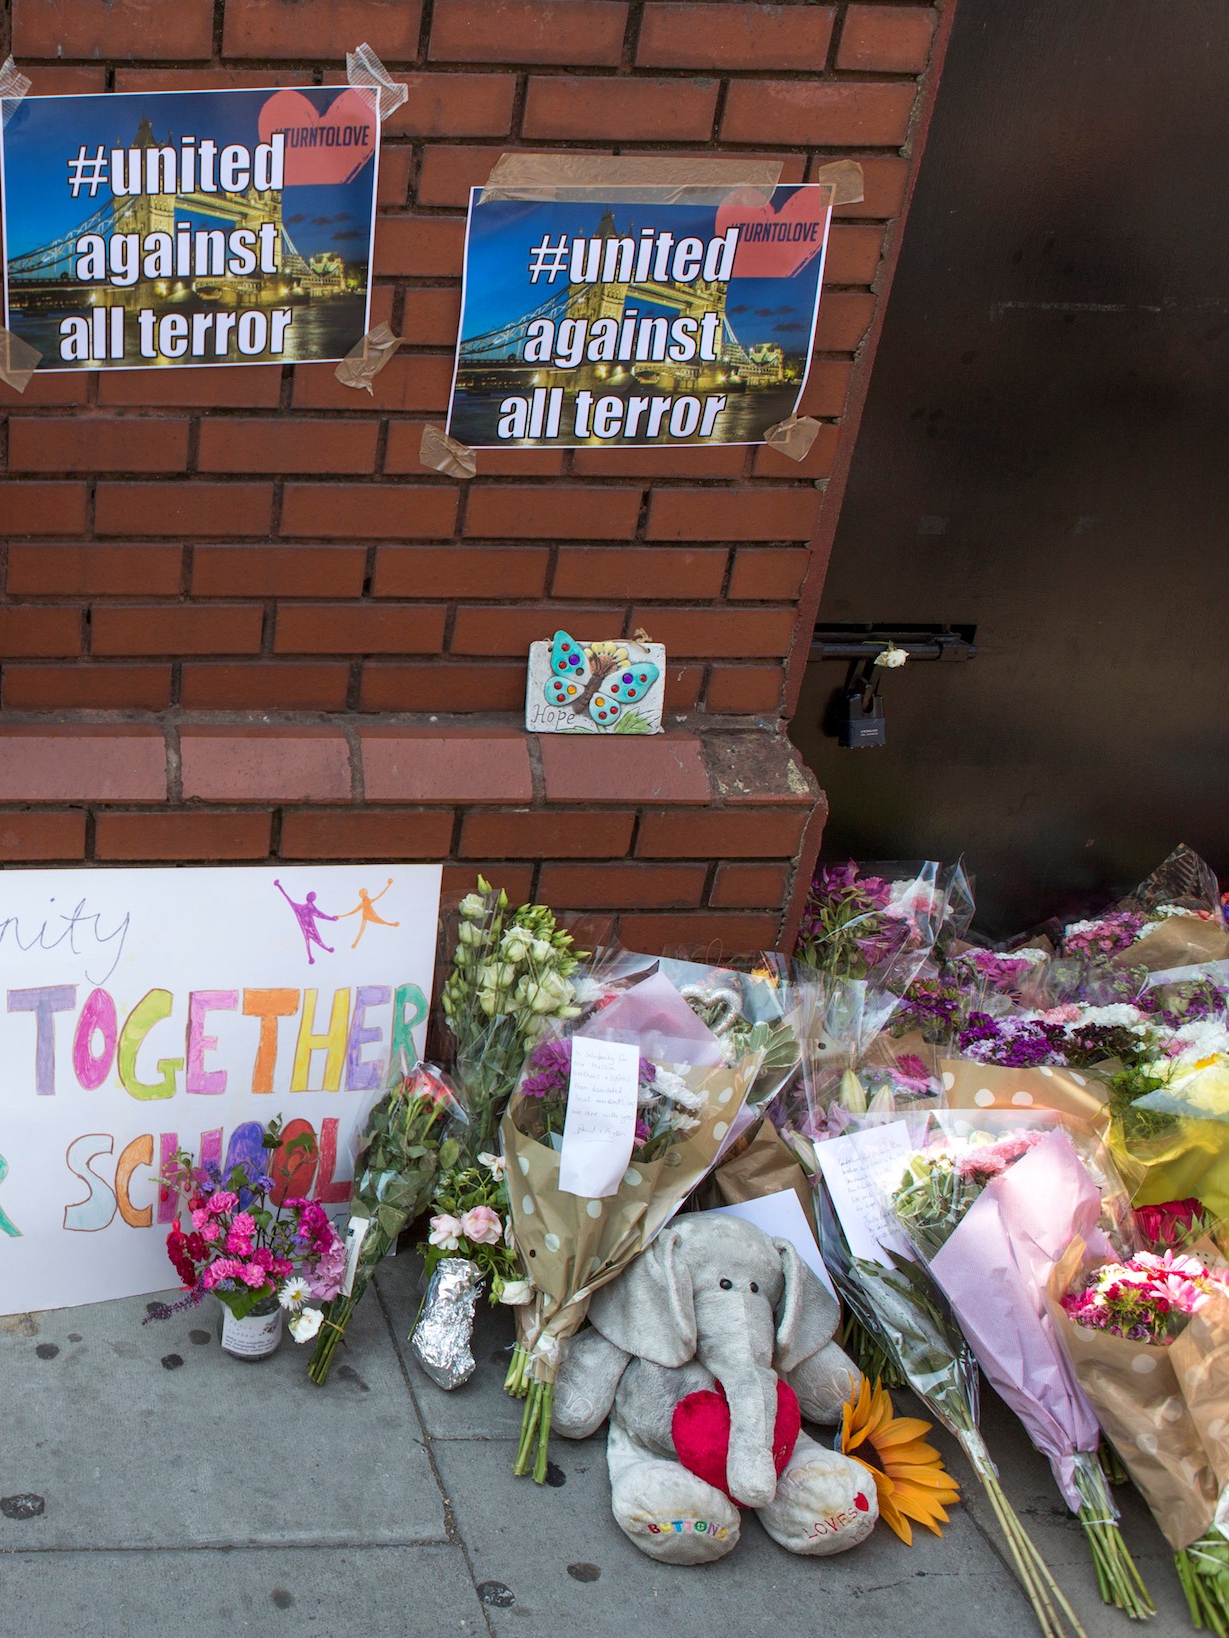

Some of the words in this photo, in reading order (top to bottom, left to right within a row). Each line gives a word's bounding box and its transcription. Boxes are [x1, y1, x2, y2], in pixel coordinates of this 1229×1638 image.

[67, 132, 285, 198] #united
[74, 222, 278, 287] against
[528, 227, 740, 285] #united
[59, 306, 125, 361] all
[138, 306, 292, 358] terror
[523, 309, 721, 369] against
[497, 387, 564, 440] all
[574, 390, 727, 439] terror
[531, 704, 576, 731] Hope
[7, 983, 429, 1101] TOGETHER
[63, 1116, 355, 1233] SCHOOL
[647, 1521, 728, 1540] BUTTONS
[802, 1507, 858, 1539] LOVES
